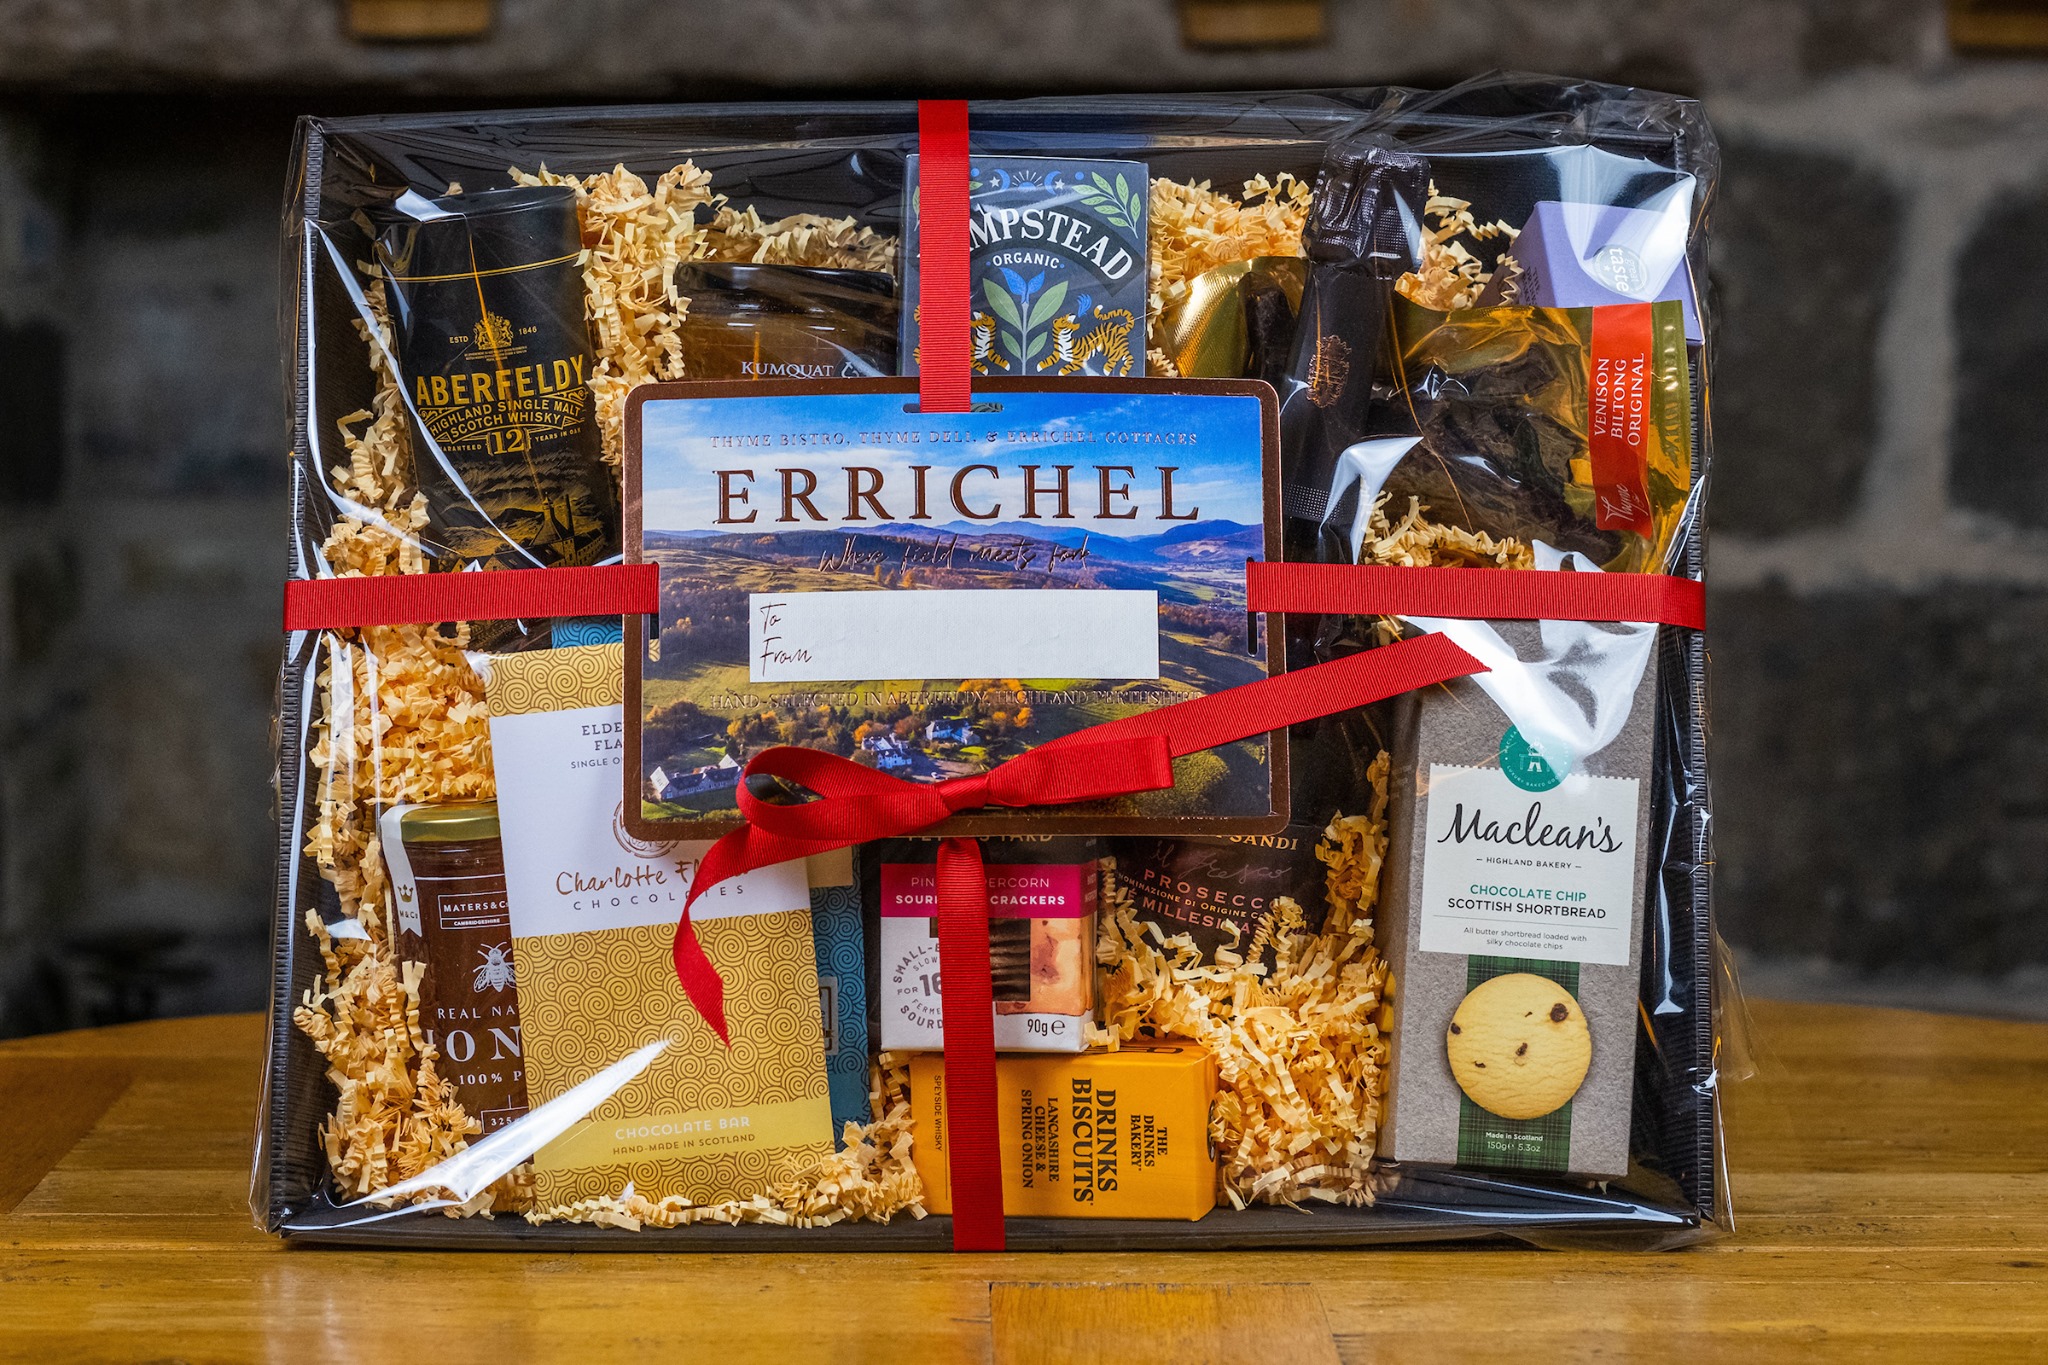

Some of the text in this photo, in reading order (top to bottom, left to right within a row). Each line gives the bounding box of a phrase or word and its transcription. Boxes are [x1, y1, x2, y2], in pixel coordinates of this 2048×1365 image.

[970, 208, 1133, 280] MPSTEAD
[993, 252, 1059, 269] ORGANIC
[1609, 248, 1629, 292] taste
[449, 326, 537, 344] ESTD 1846
[416, 354, 584, 406] ABERFELDY
[741, 361, 834, 379] KUMQUAT
[1594, 358, 1610, 436] VENISON
[1611, 359, 1627, 439] BILTONG
[1627, 353, 1645, 446] ORIGINAL
[429, 399, 581, 436] HIGHLAND SINGLE MALT
[450, 411, 562, 438] SCOTCH WHISKY
[440, 444, 482, 452] ARANTEED
[491, 428, 526, 455] 12
[710, 435, 771, 448] THYME
[780, 432, 851, 446] BISTRO,
[859, 431, 921, 444] THYME
[986, 431, 998, 443] &
[1007, 431, 1097, 443] ERRICHEL
[1105, 431, 1198, 445] COTTAGES
[711, 464, 1199, 525] ERRICHEL
[817, 534, 889, 573] Where
[900, 533, 958, 574] field
[969, 539, 1037, 571] meets
[760, 602, 787, 634] To
[760, 636, 812, 677] From
[710, 690, 859, 710] HAND-SELECTED
[864, 691, 882, 706] IN
[571, 758, 608, 769] SINGLE
[1437, 801, 1623, 853] Maclean's
[1486, 857, 1572, 870] HIGHLAND BAKERY
[556, 864, 668, 895] Charlotte
[985, 877, 1050, 888] ERCORN
[1143, 868, 1276, 910] PROSECC
[1470, 884, 1587, 902] CHOCOLATE CHIP
[990, 895, 1066, 905] CRACKERS
[1184, 899, 1197, 908] DI
[1200, 902, 1247, 918] ORIGINE
[1448, 897, 1606, 919] SCOTTISH SHORTBREAD
[1464, 927, 1588, 943] All butter shortbread loaded with
[1486, 938, 1563, 951] silky chocolate chips
[913, 957, 938, 972] SLOW
[897, 986, 919, 995] FOR
[437, 1007, 481, 1020] REAL
[459, 1072, 503, 1085] 100%
[934, 1075, 942, 1151] SPEYSIDE WHISKY
[615, 1116, 751, 1140] CHOCOLATE BAR
[1021, 1089, 1034, 1189] SPRING ONION
[1034, 1105, 1046, 1173] CHEESE &
[1047, 1097, 1059, 1182] LANCASHIRE
[1072, 1078, 1094, 1203] BISCUITS
[1096, 1089, 1118, 1192] DRINKS
[1143, 1115, 1155, 1167] DRINKS
[1157, 1127, 1167, 1155] THE
[1513, 1134, 1543, 1142] Scotland
[613, 1133, 756, 1155] HAND-MADE IN SCOTLAND
[1518, 1143, 1541, 1152] 5.3oz
